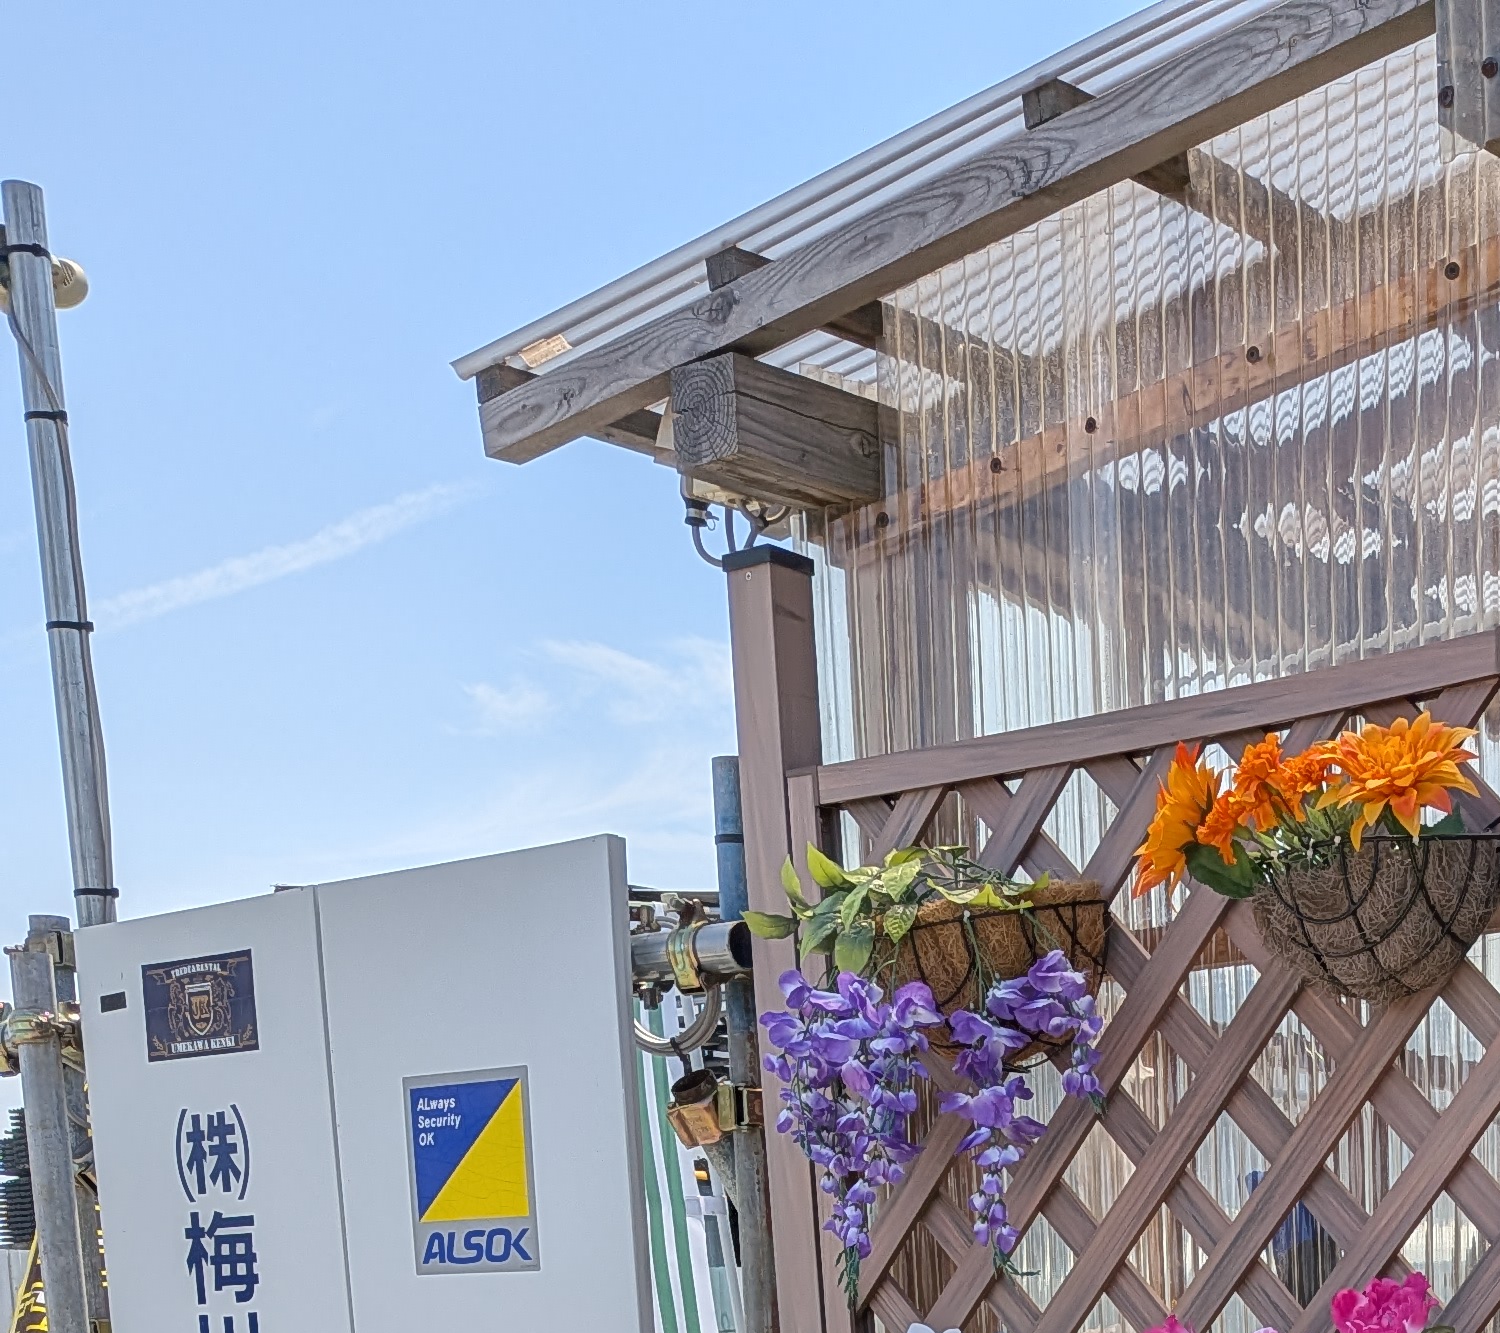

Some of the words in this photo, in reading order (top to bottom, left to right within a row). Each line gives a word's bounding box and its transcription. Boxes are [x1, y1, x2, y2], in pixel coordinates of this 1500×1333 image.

[211, 1035, 236, 1049] KENKI
[417, 1097, 456, 1112] ALways
[417, 1113, 462, 1129] Security
[419, 1132, 435, 1146] OK
[422, 1227, 533, 1265] ALSOK
